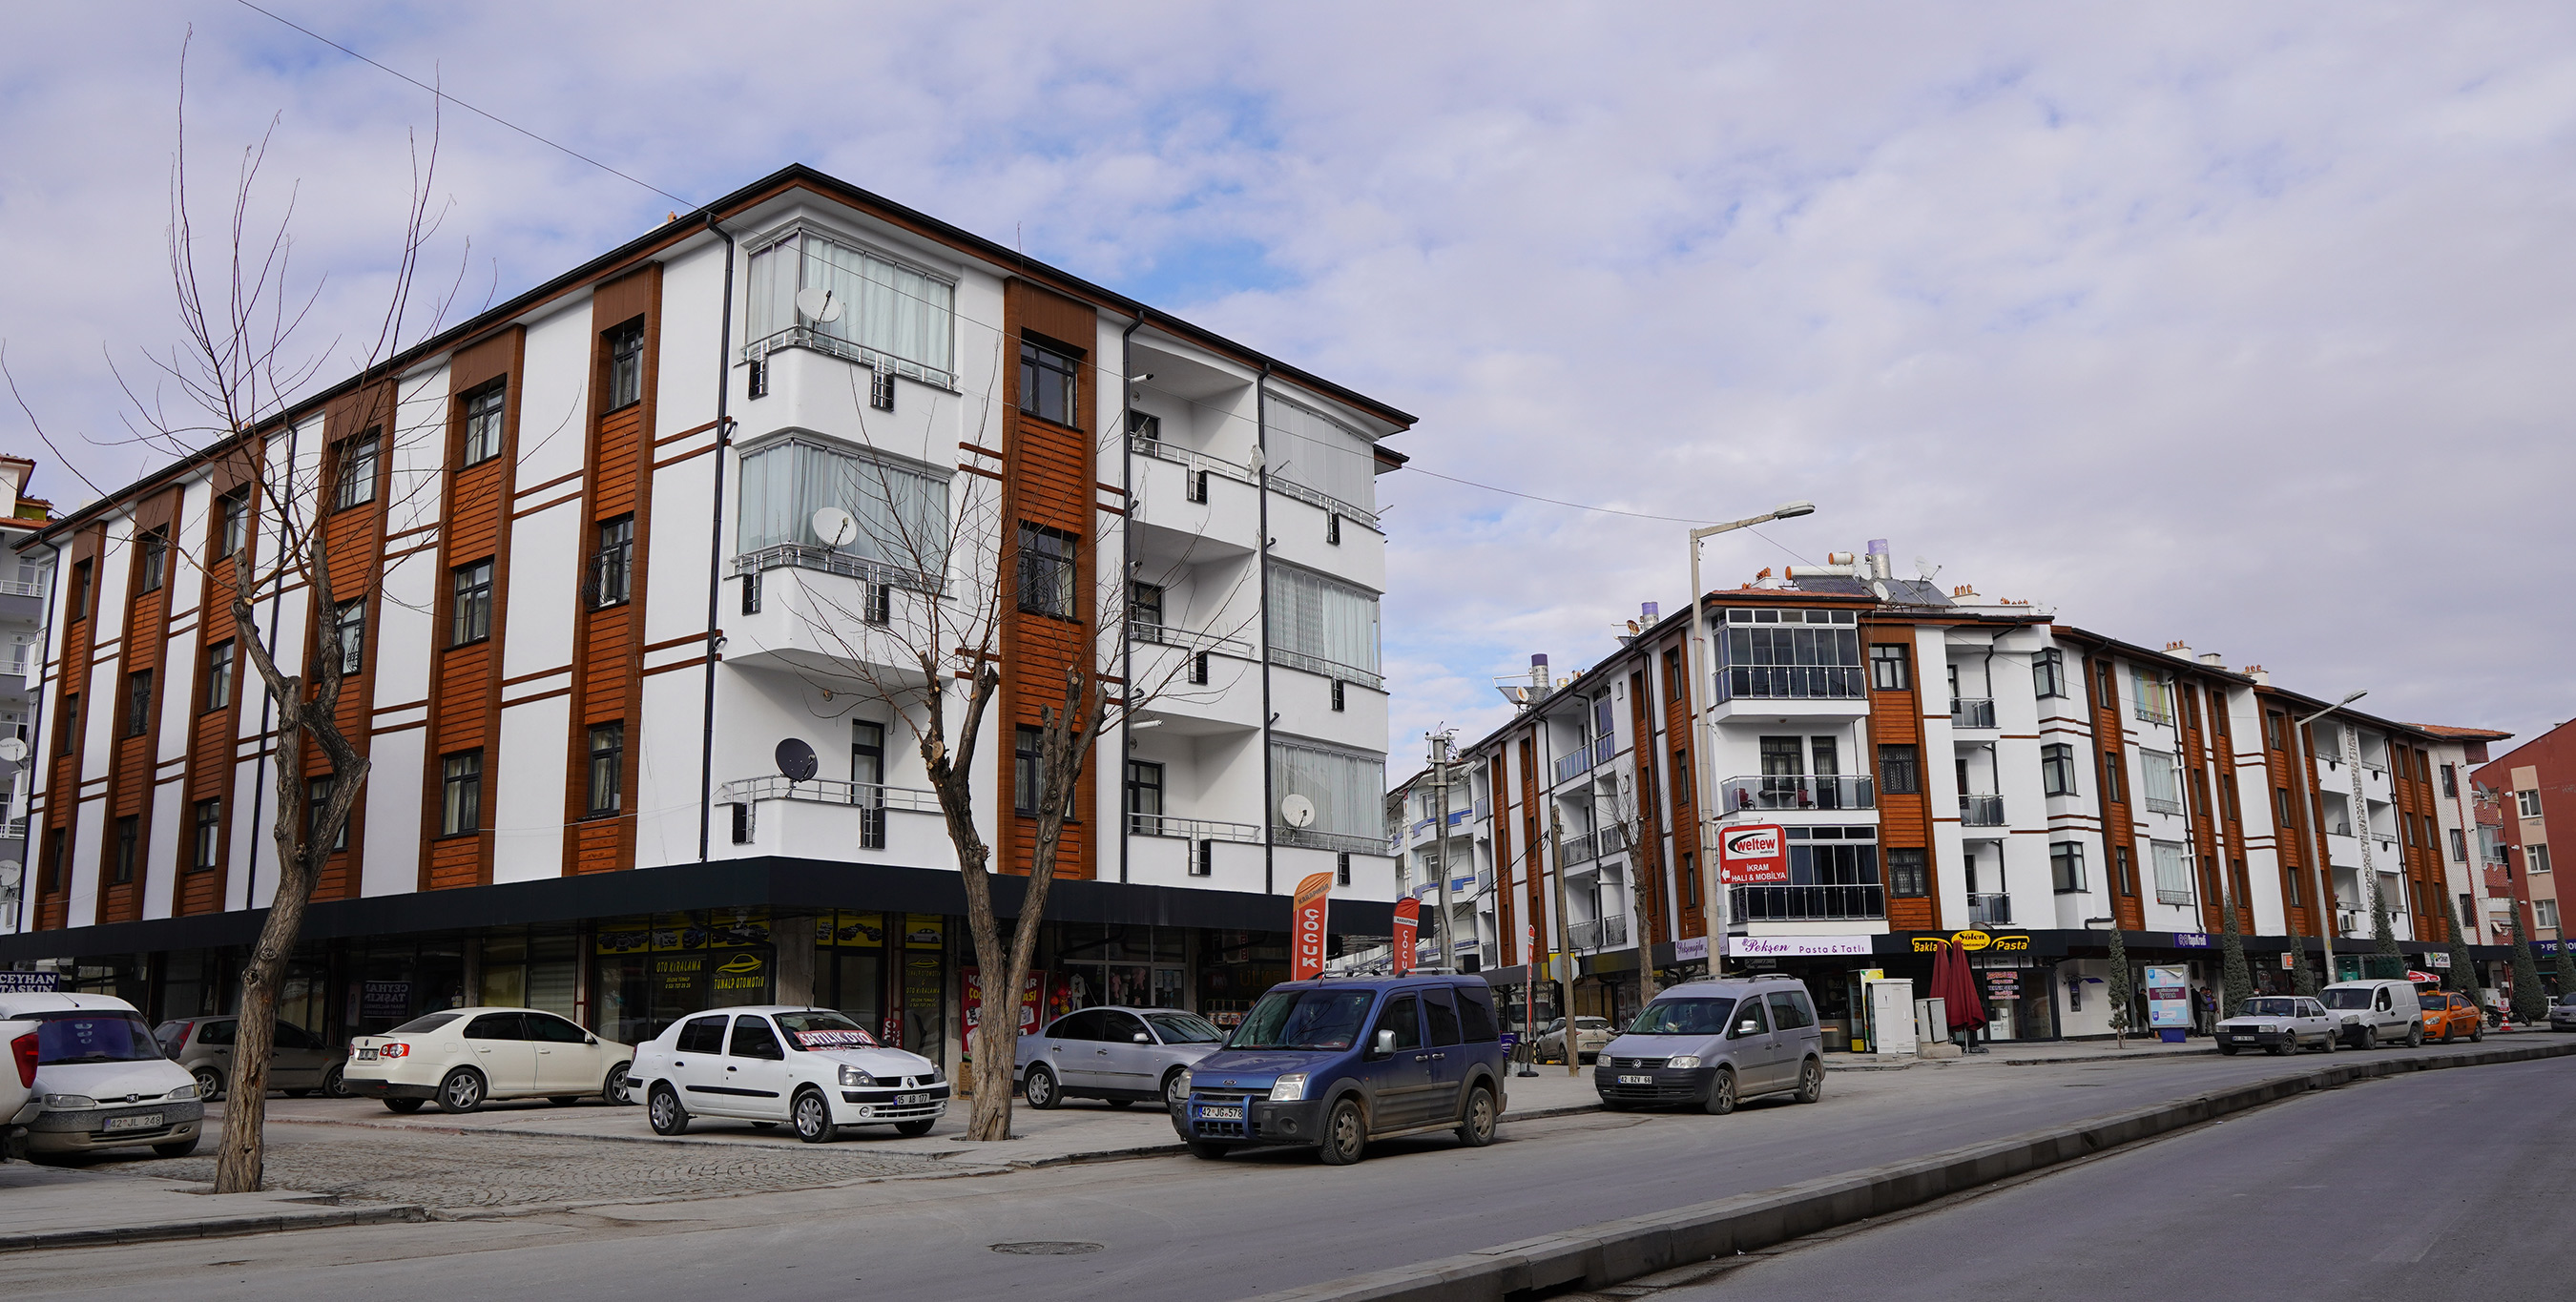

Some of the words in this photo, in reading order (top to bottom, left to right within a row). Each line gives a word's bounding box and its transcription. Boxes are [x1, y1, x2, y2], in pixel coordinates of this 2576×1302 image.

[1736, 837, 1776, 852] weltew
[1746, 863, 1769, 872] İKRAM
[1732, 874, 1748, 882] HALI
[1755, 872, 1786, 880] MOBİLYA
[1298, 883, 1329, 905] KARAPINAR
[1396, 918, 1417, 926] KARAPINAR
[1301, 908, 1319, 968] ÇOCUK
[1799, 945, 1828, 954] Pasta
[1841, 944, 1865, 953] Tatlı
[1997, 941, 2027, 951] Pasta
[655, 961, 669, 973] OTO
[0, 974, 57, 984] CEYHAN
[799, 1031, 846, 1046] SATILIK
[845, 1031, 872, 1044] OTO
[1202, 1107, 1211, 1117] 42
[1215, 1107, 1225, 1117] JG
[1228, 1107, 1243, 1118] 578
[111, 1119, 122, 1128] 42
[128, 1118, 139, 1126] JL
[144, 1116, 161, 1126] 248
